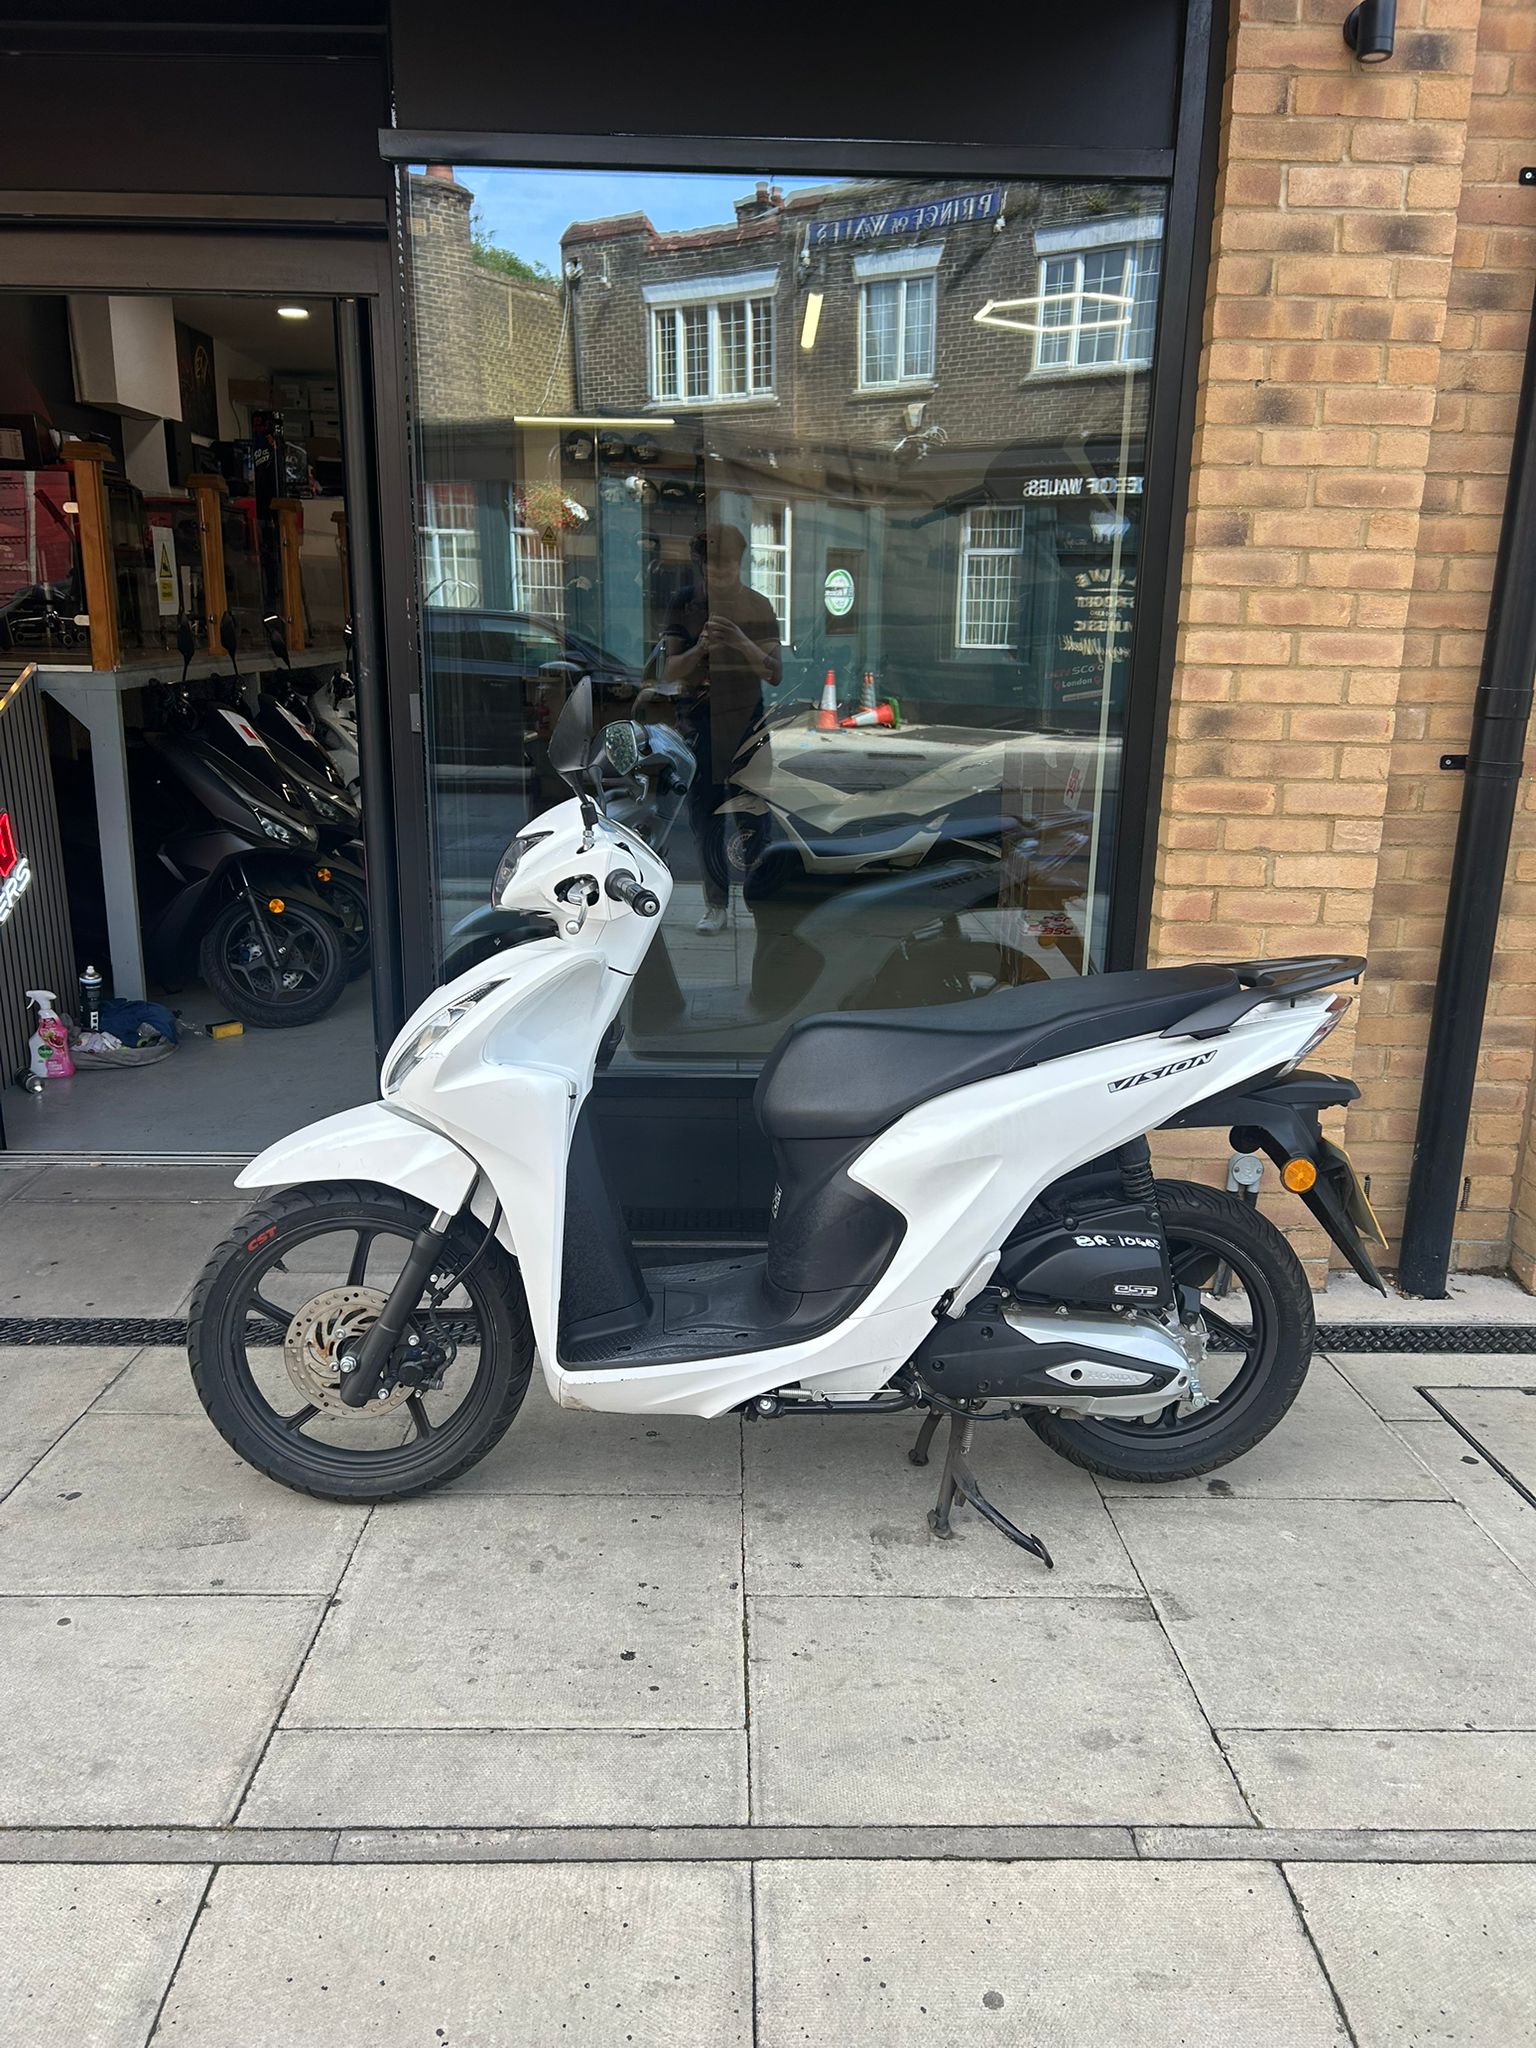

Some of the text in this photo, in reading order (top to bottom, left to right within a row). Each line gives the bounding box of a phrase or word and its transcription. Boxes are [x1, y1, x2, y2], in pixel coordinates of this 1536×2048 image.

[1062, 677, 1093, 688] London
[1108, 1050, 1217, 1093] VISION
[247, 1225, 276, 1251] CST
[1089, 1370, 1139, 1383] HONDA
